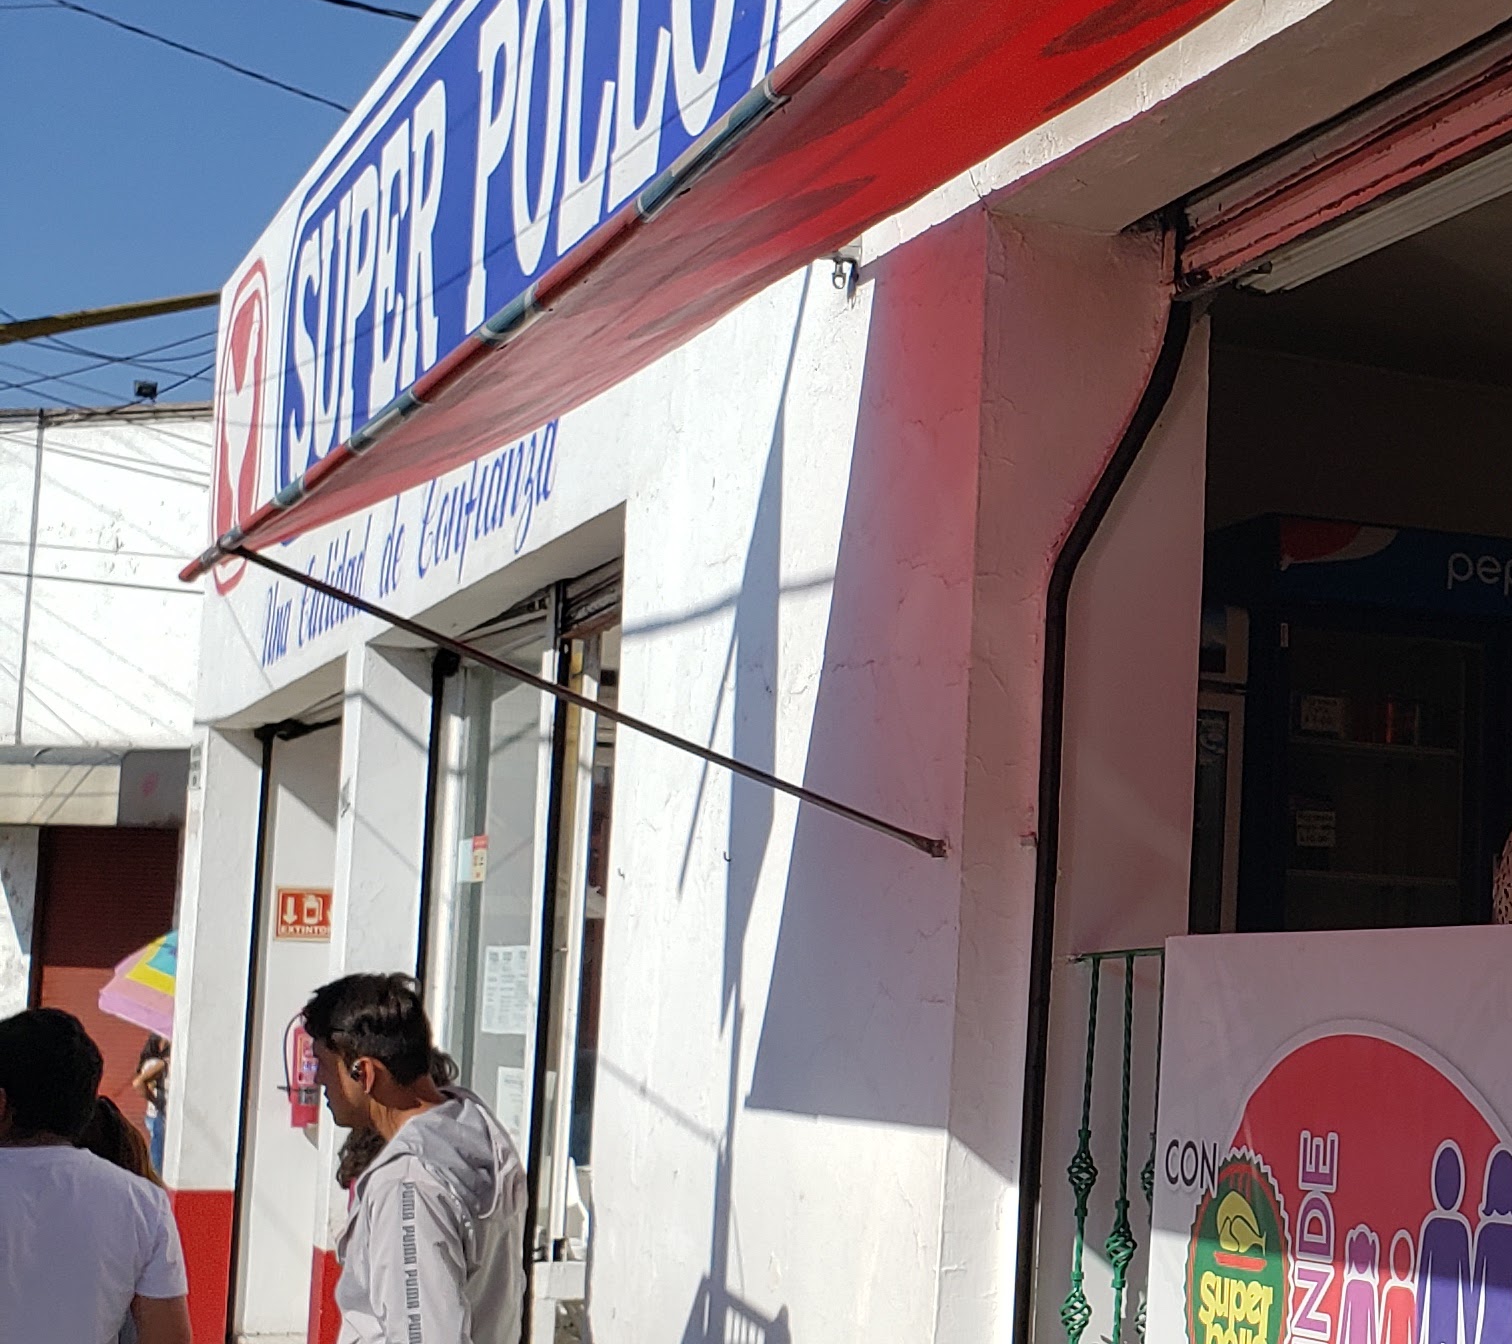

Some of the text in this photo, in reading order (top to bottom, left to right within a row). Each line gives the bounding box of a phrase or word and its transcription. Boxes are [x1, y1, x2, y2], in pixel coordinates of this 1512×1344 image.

[288, 79, 446, 481] SUPER
[262, 581, 293, 668] Una
[379, 494, 405, 599] de
[1164, 1138, 1219, 1191] CON
[1198, 1270, 1274, 1330] super
